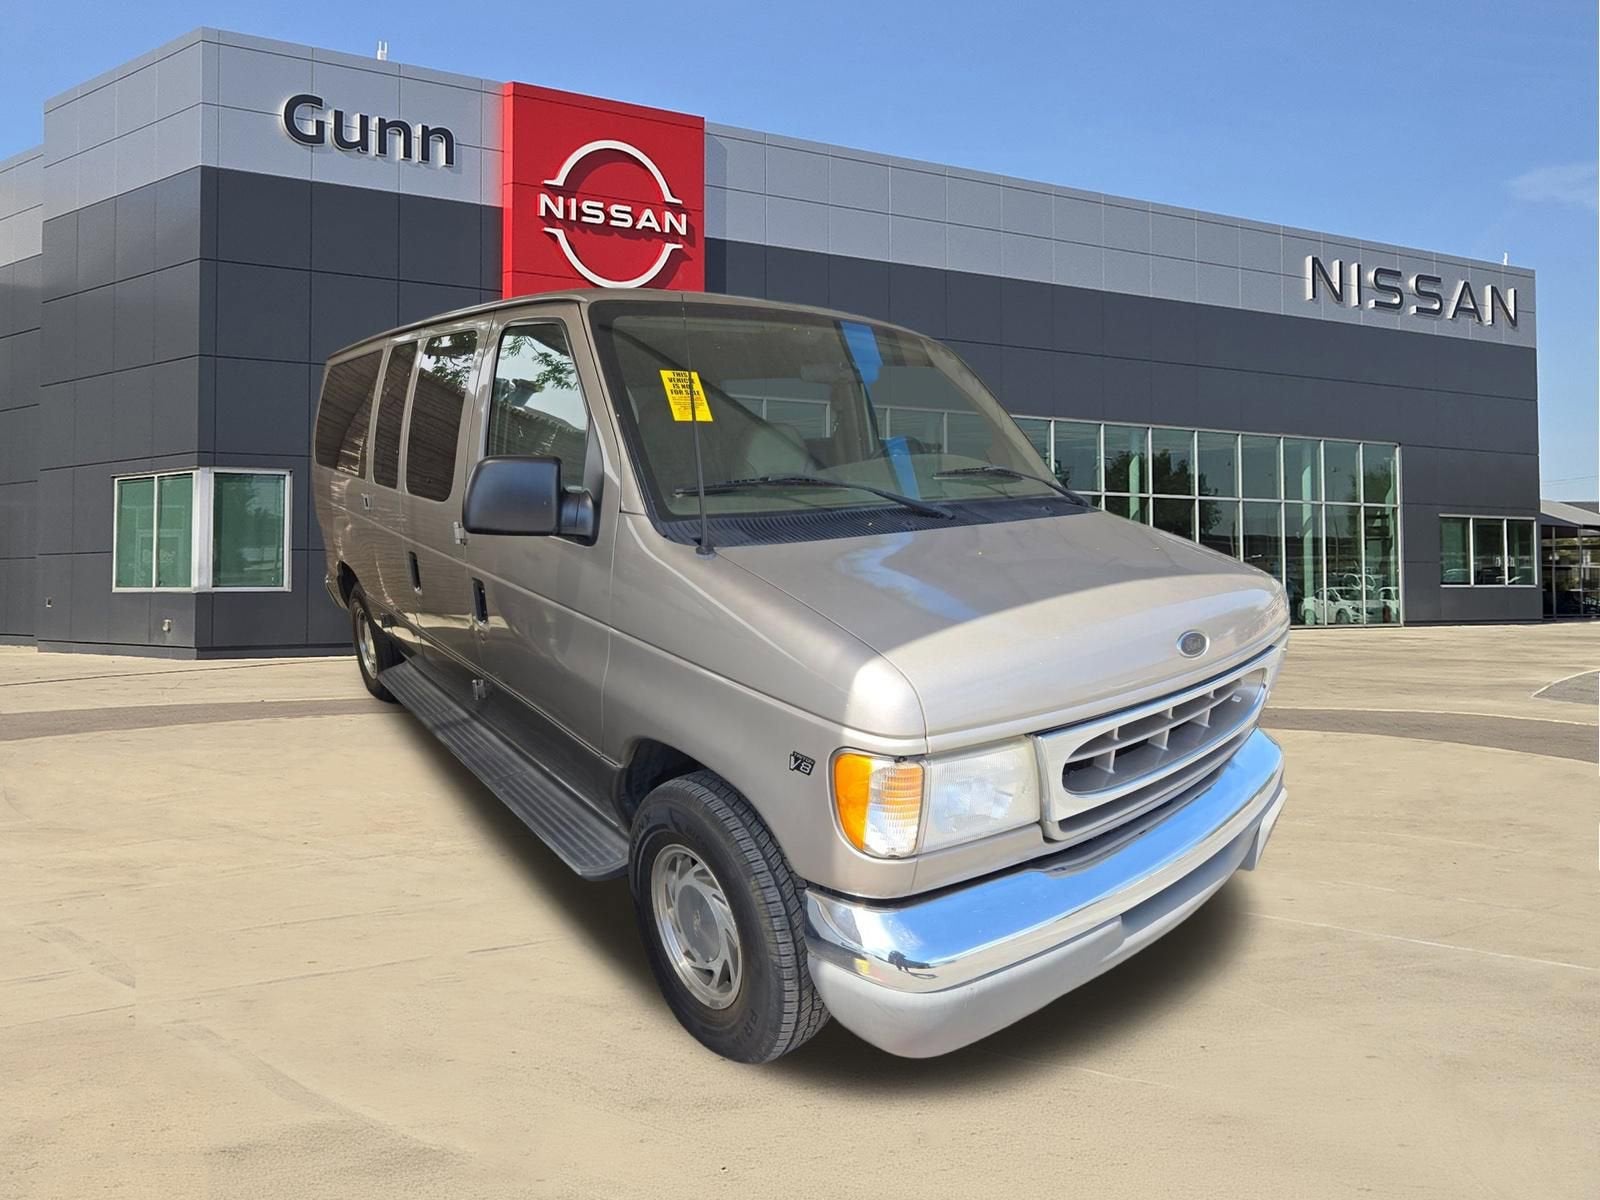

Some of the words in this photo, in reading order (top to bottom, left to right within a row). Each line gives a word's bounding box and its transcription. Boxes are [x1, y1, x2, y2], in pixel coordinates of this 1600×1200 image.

[281, 93, 455, 168] Gunn
[537, 193, 687, 236] NISSAN
[1305, 255, 1518, 328] NISSAN
[790, 755, 812, 774] V8
